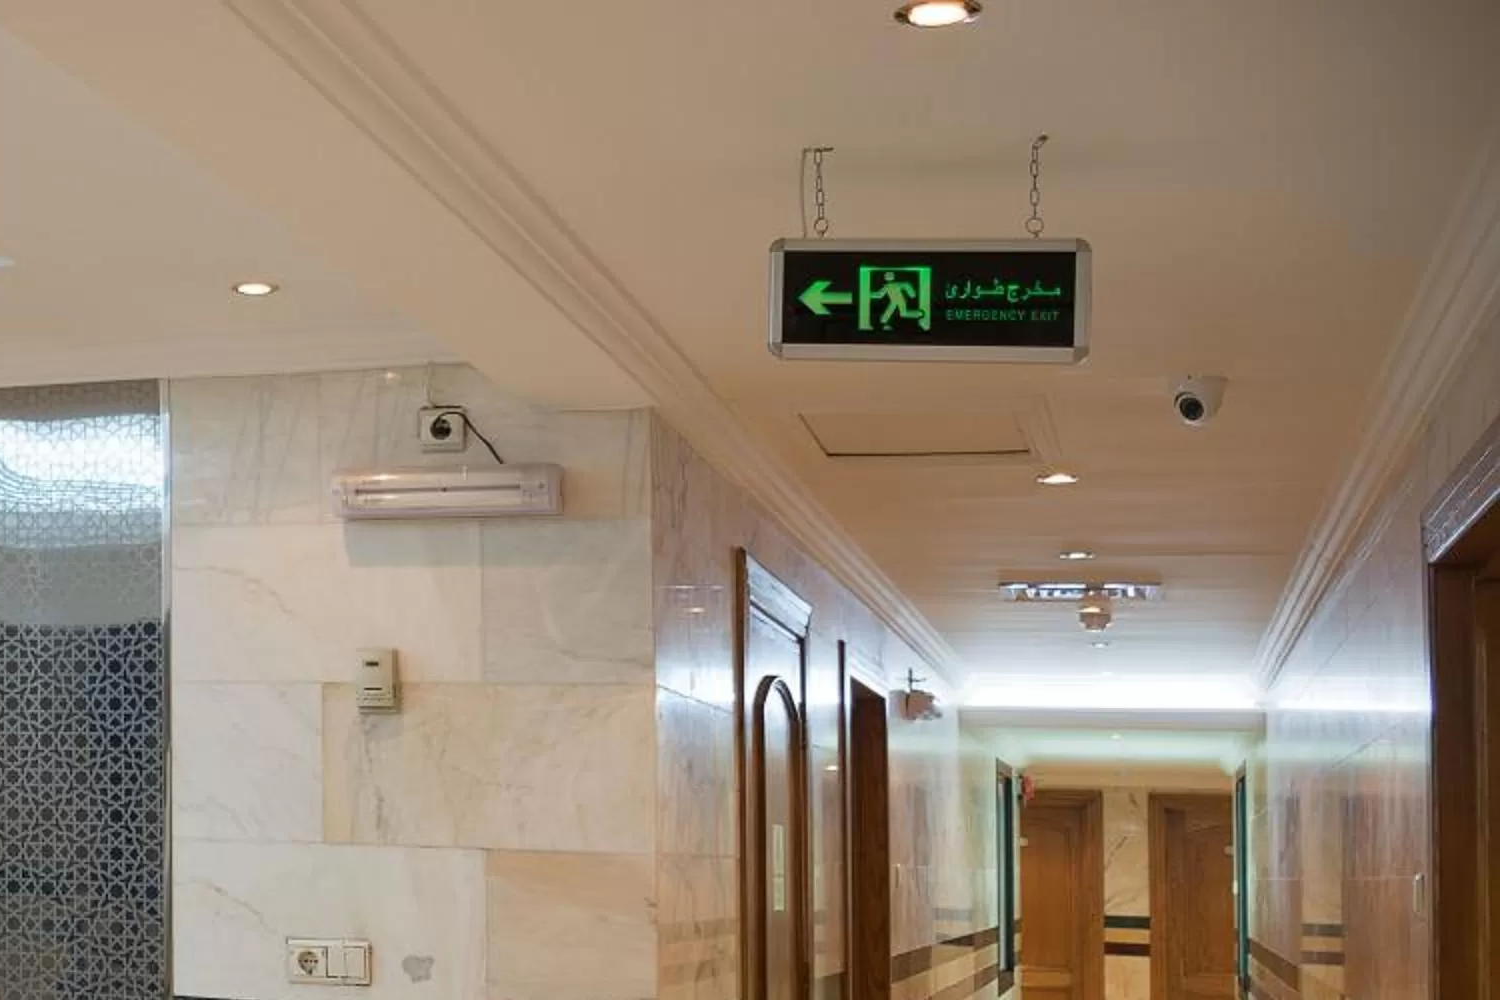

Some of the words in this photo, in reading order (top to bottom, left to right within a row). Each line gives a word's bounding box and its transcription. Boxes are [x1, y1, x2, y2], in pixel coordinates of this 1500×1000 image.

[1007, 280, 1061, 302] مخرج
[946, 309, 1025, 321] EMERGENCY
[1030, 310, 1060, 321] EXIT
